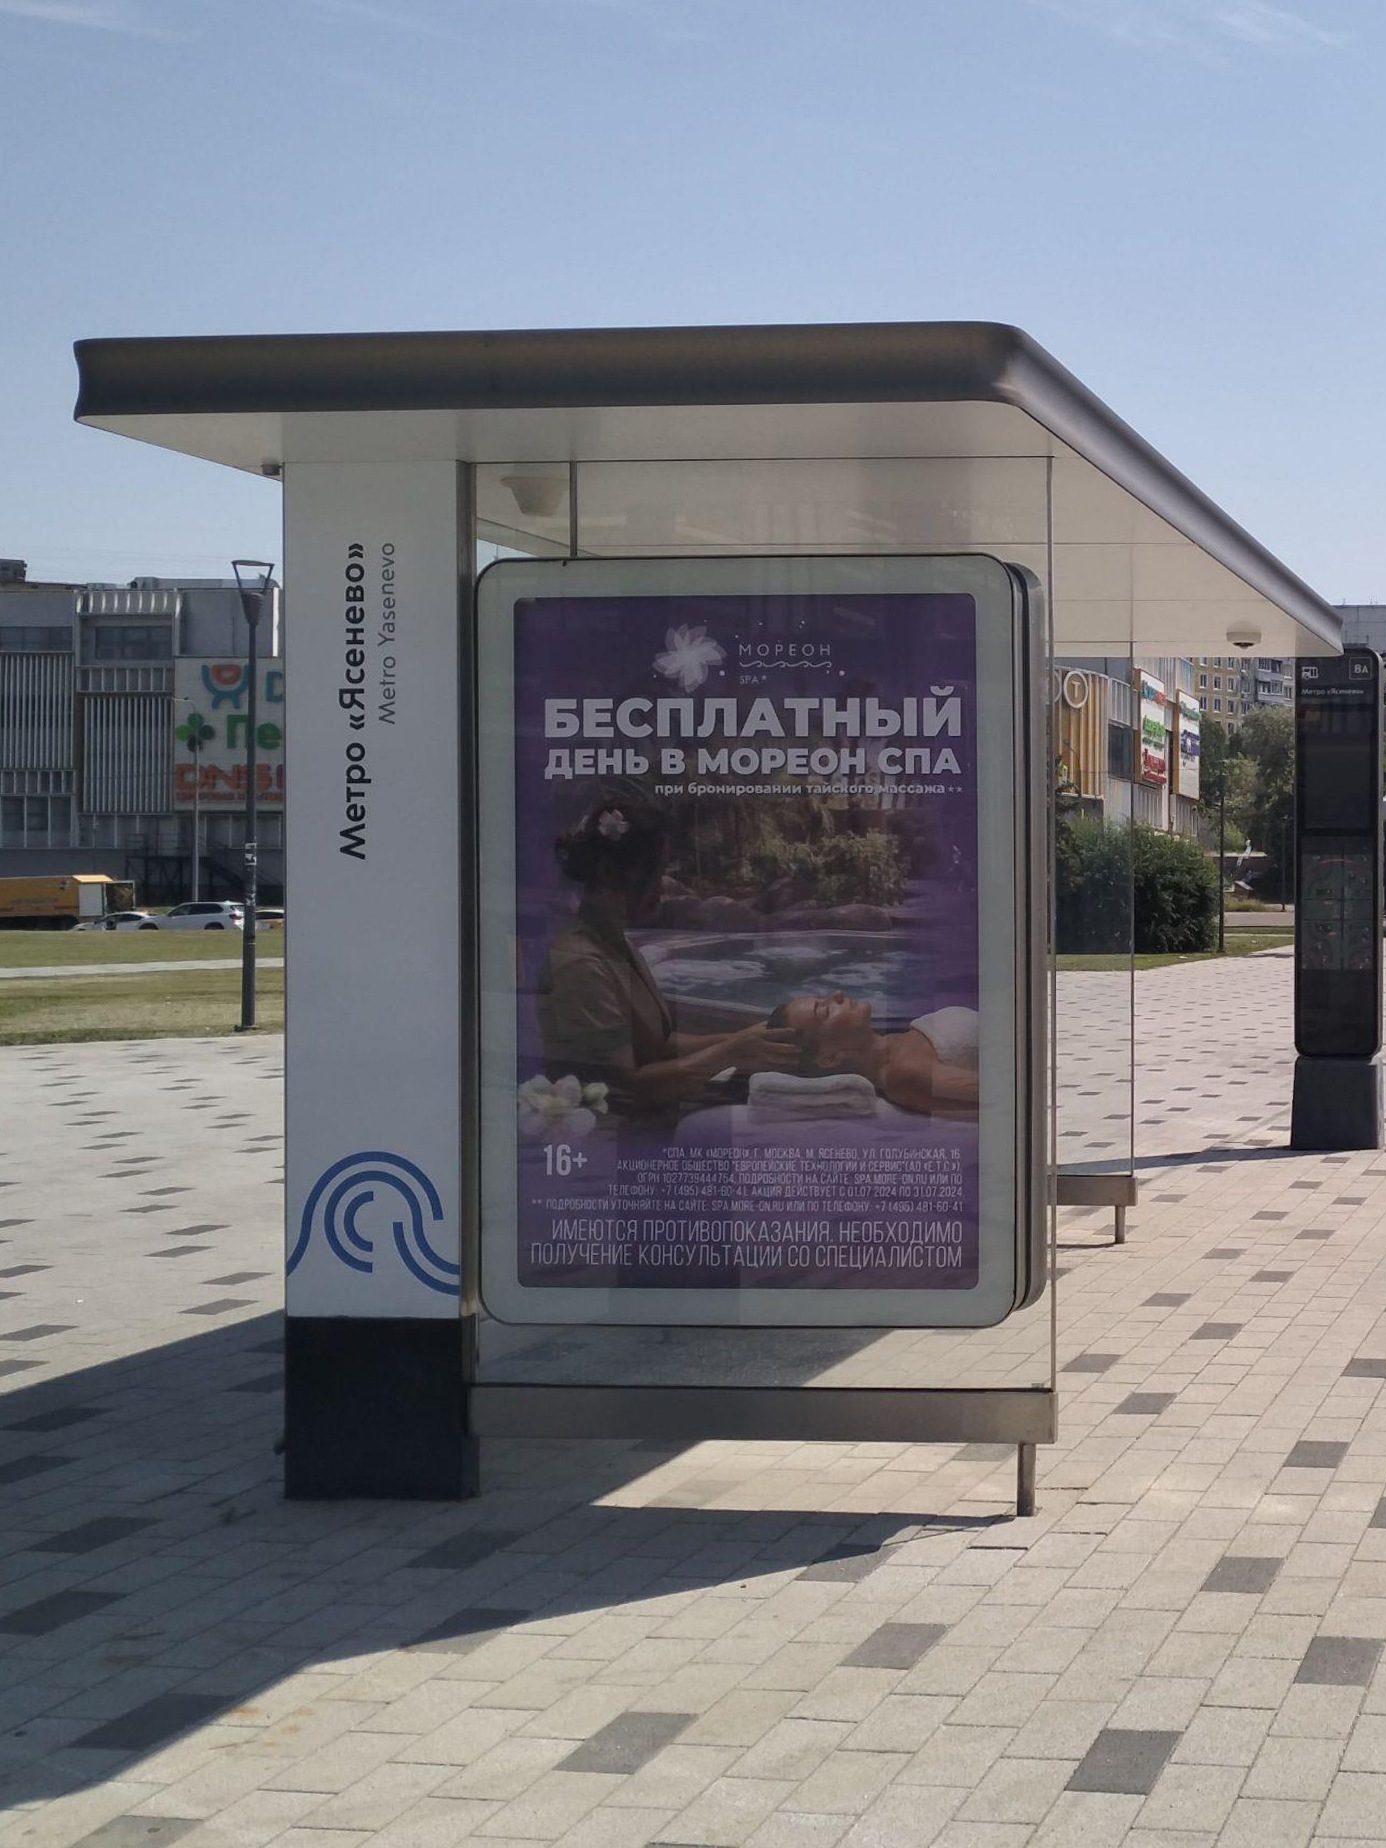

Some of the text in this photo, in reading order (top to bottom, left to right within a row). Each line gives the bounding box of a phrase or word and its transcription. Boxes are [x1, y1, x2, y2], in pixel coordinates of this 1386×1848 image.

[378, 543, 395, 724] Metro Yasenevo
[739, 643, 831, 656] МОРЕОН
[339, 543, 372, 859] Метро «Ясенево»
[544, 685, 962, 738] БЕСПЛАТНЫЙ
[544, 747, 961, 780] ДЕНЬ В МОРЕОН СПА
[655, 785, 683, 797] при
[688, 782, 802, 796] бронировании
[806, 782, 873, 796] тайского
[543, 1144, 588, 1176] 16+
[739, 1173, 803, 1184] ПОДРОБНОСТИ
[805, 1173, 819, 1184] НА
[546, 1199, 609, 1211] ПОДРОБНОСТИ
[664, 1200, 676, 1211] НА
[552, 1219, 962, 1244] ИМЕЮТСЯ ПРОТИВОПОКАЗАНИЯ. НЕОБХОДИМО
[531, 1243, 962, 1270] ПОЛУЧЕНИЕ КОНСУЛЬТАЦИИ СО СПЕЦИАЛИСТОМ
